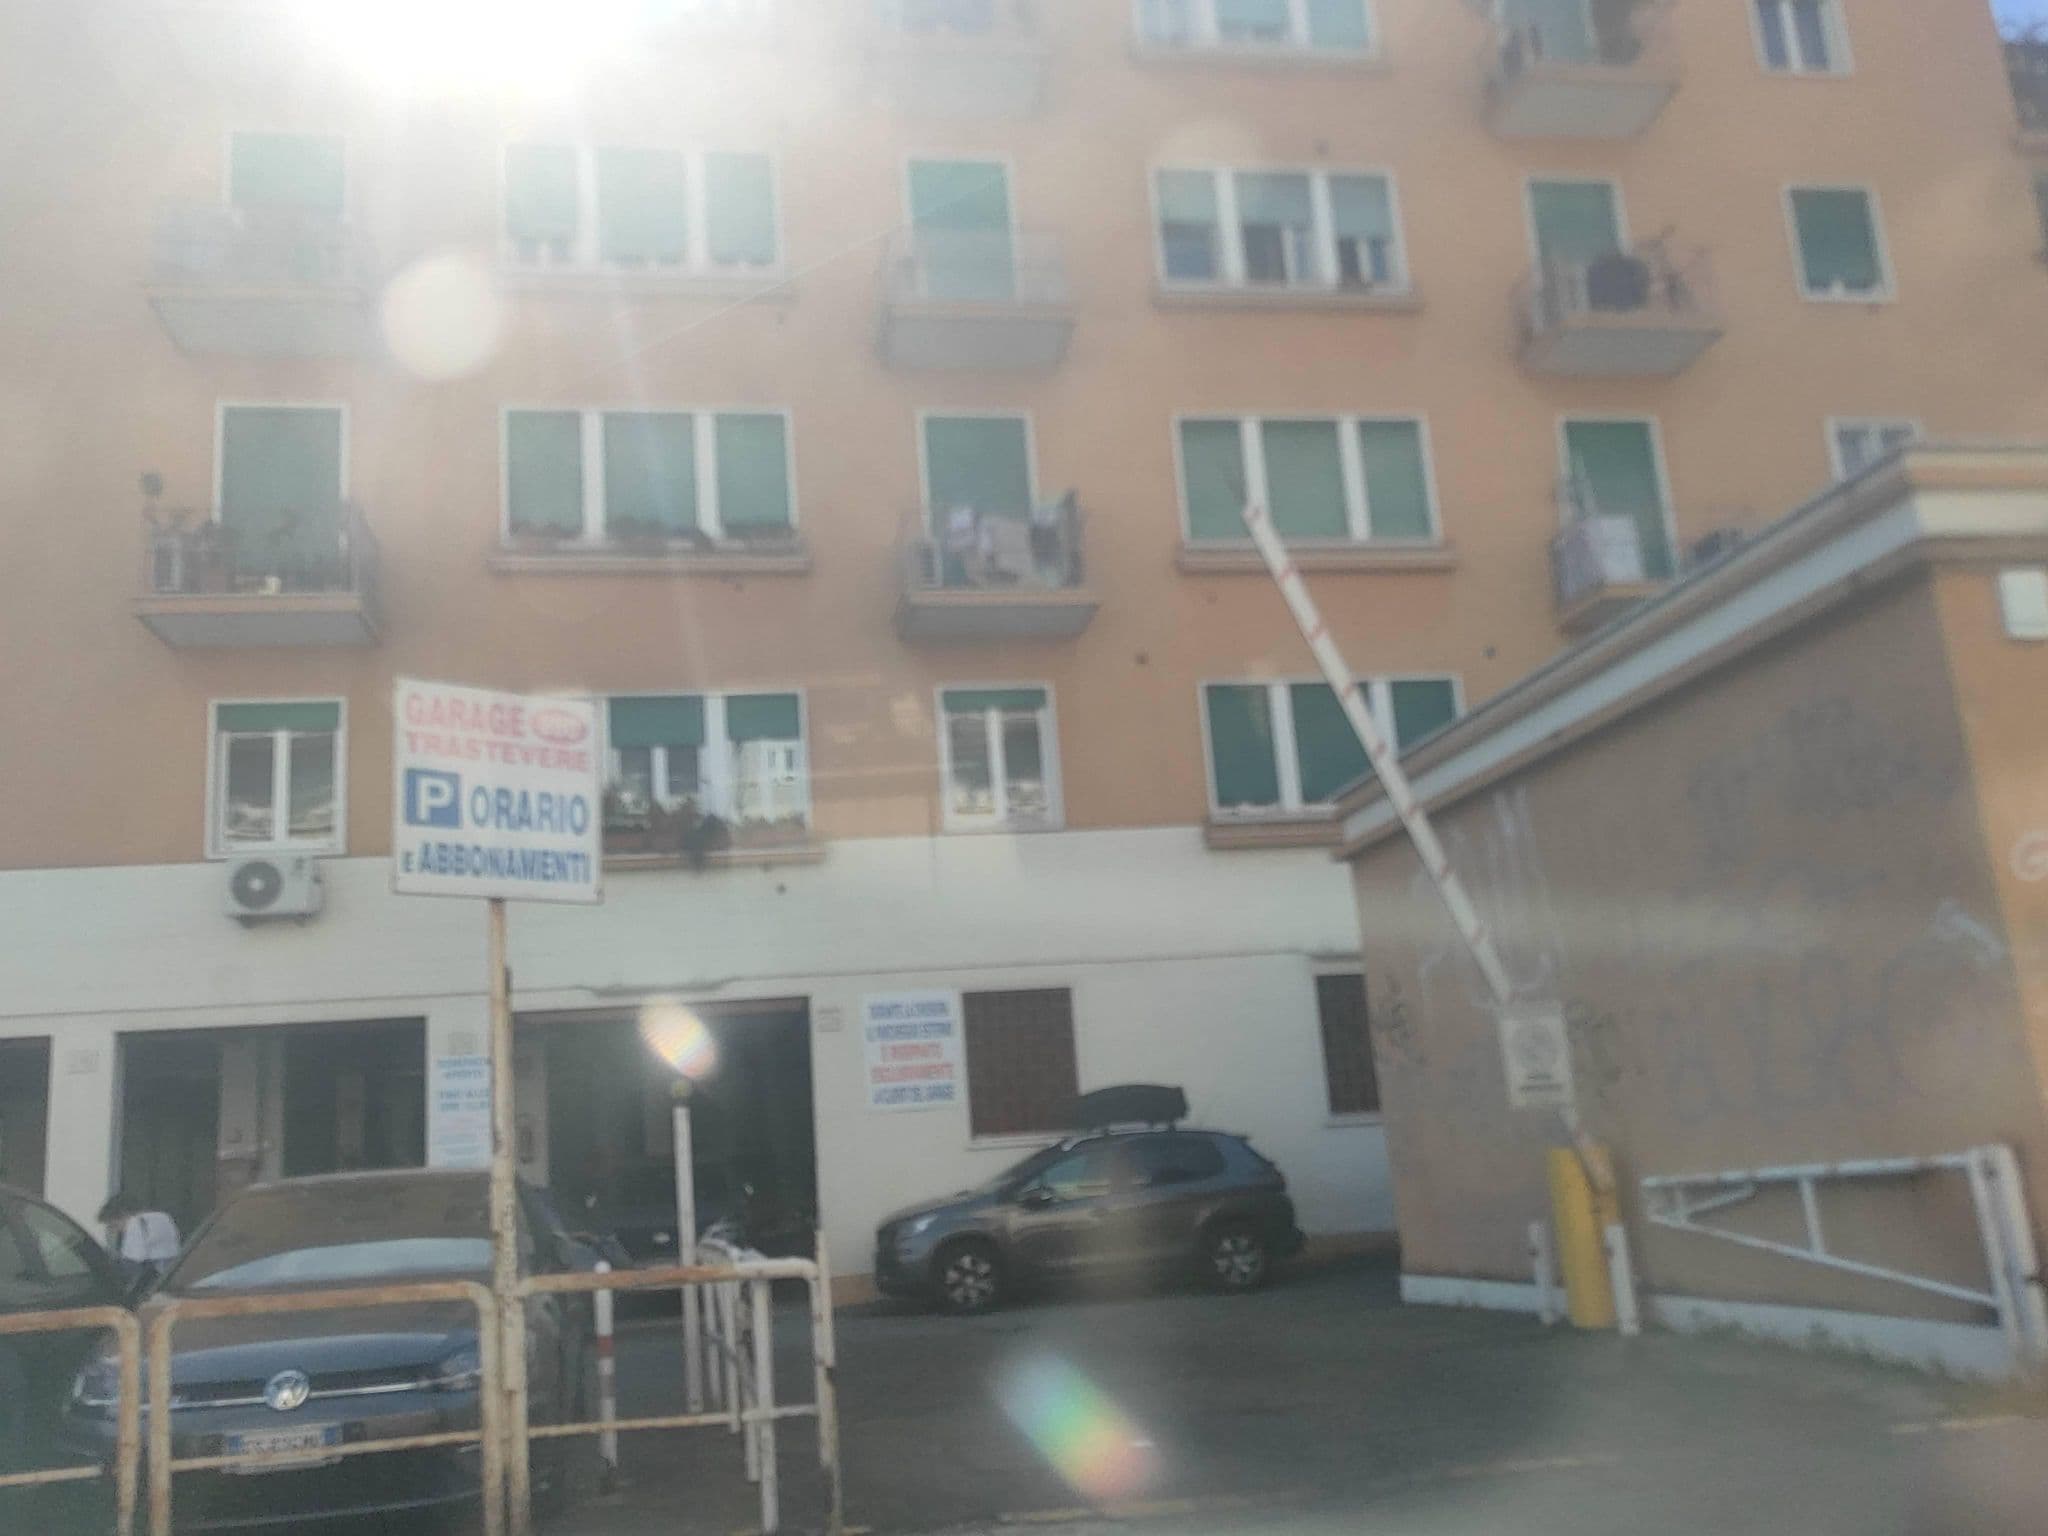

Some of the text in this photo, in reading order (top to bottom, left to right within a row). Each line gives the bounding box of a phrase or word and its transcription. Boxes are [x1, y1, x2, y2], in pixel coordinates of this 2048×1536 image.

[406, 693, 525, 737] GARAGE
[406, 731, 588, 772] TRASTEVERE
[416, 776, 588, 836] P ORARIO
[419, 842, 591, 883] ABBONAMENTI
